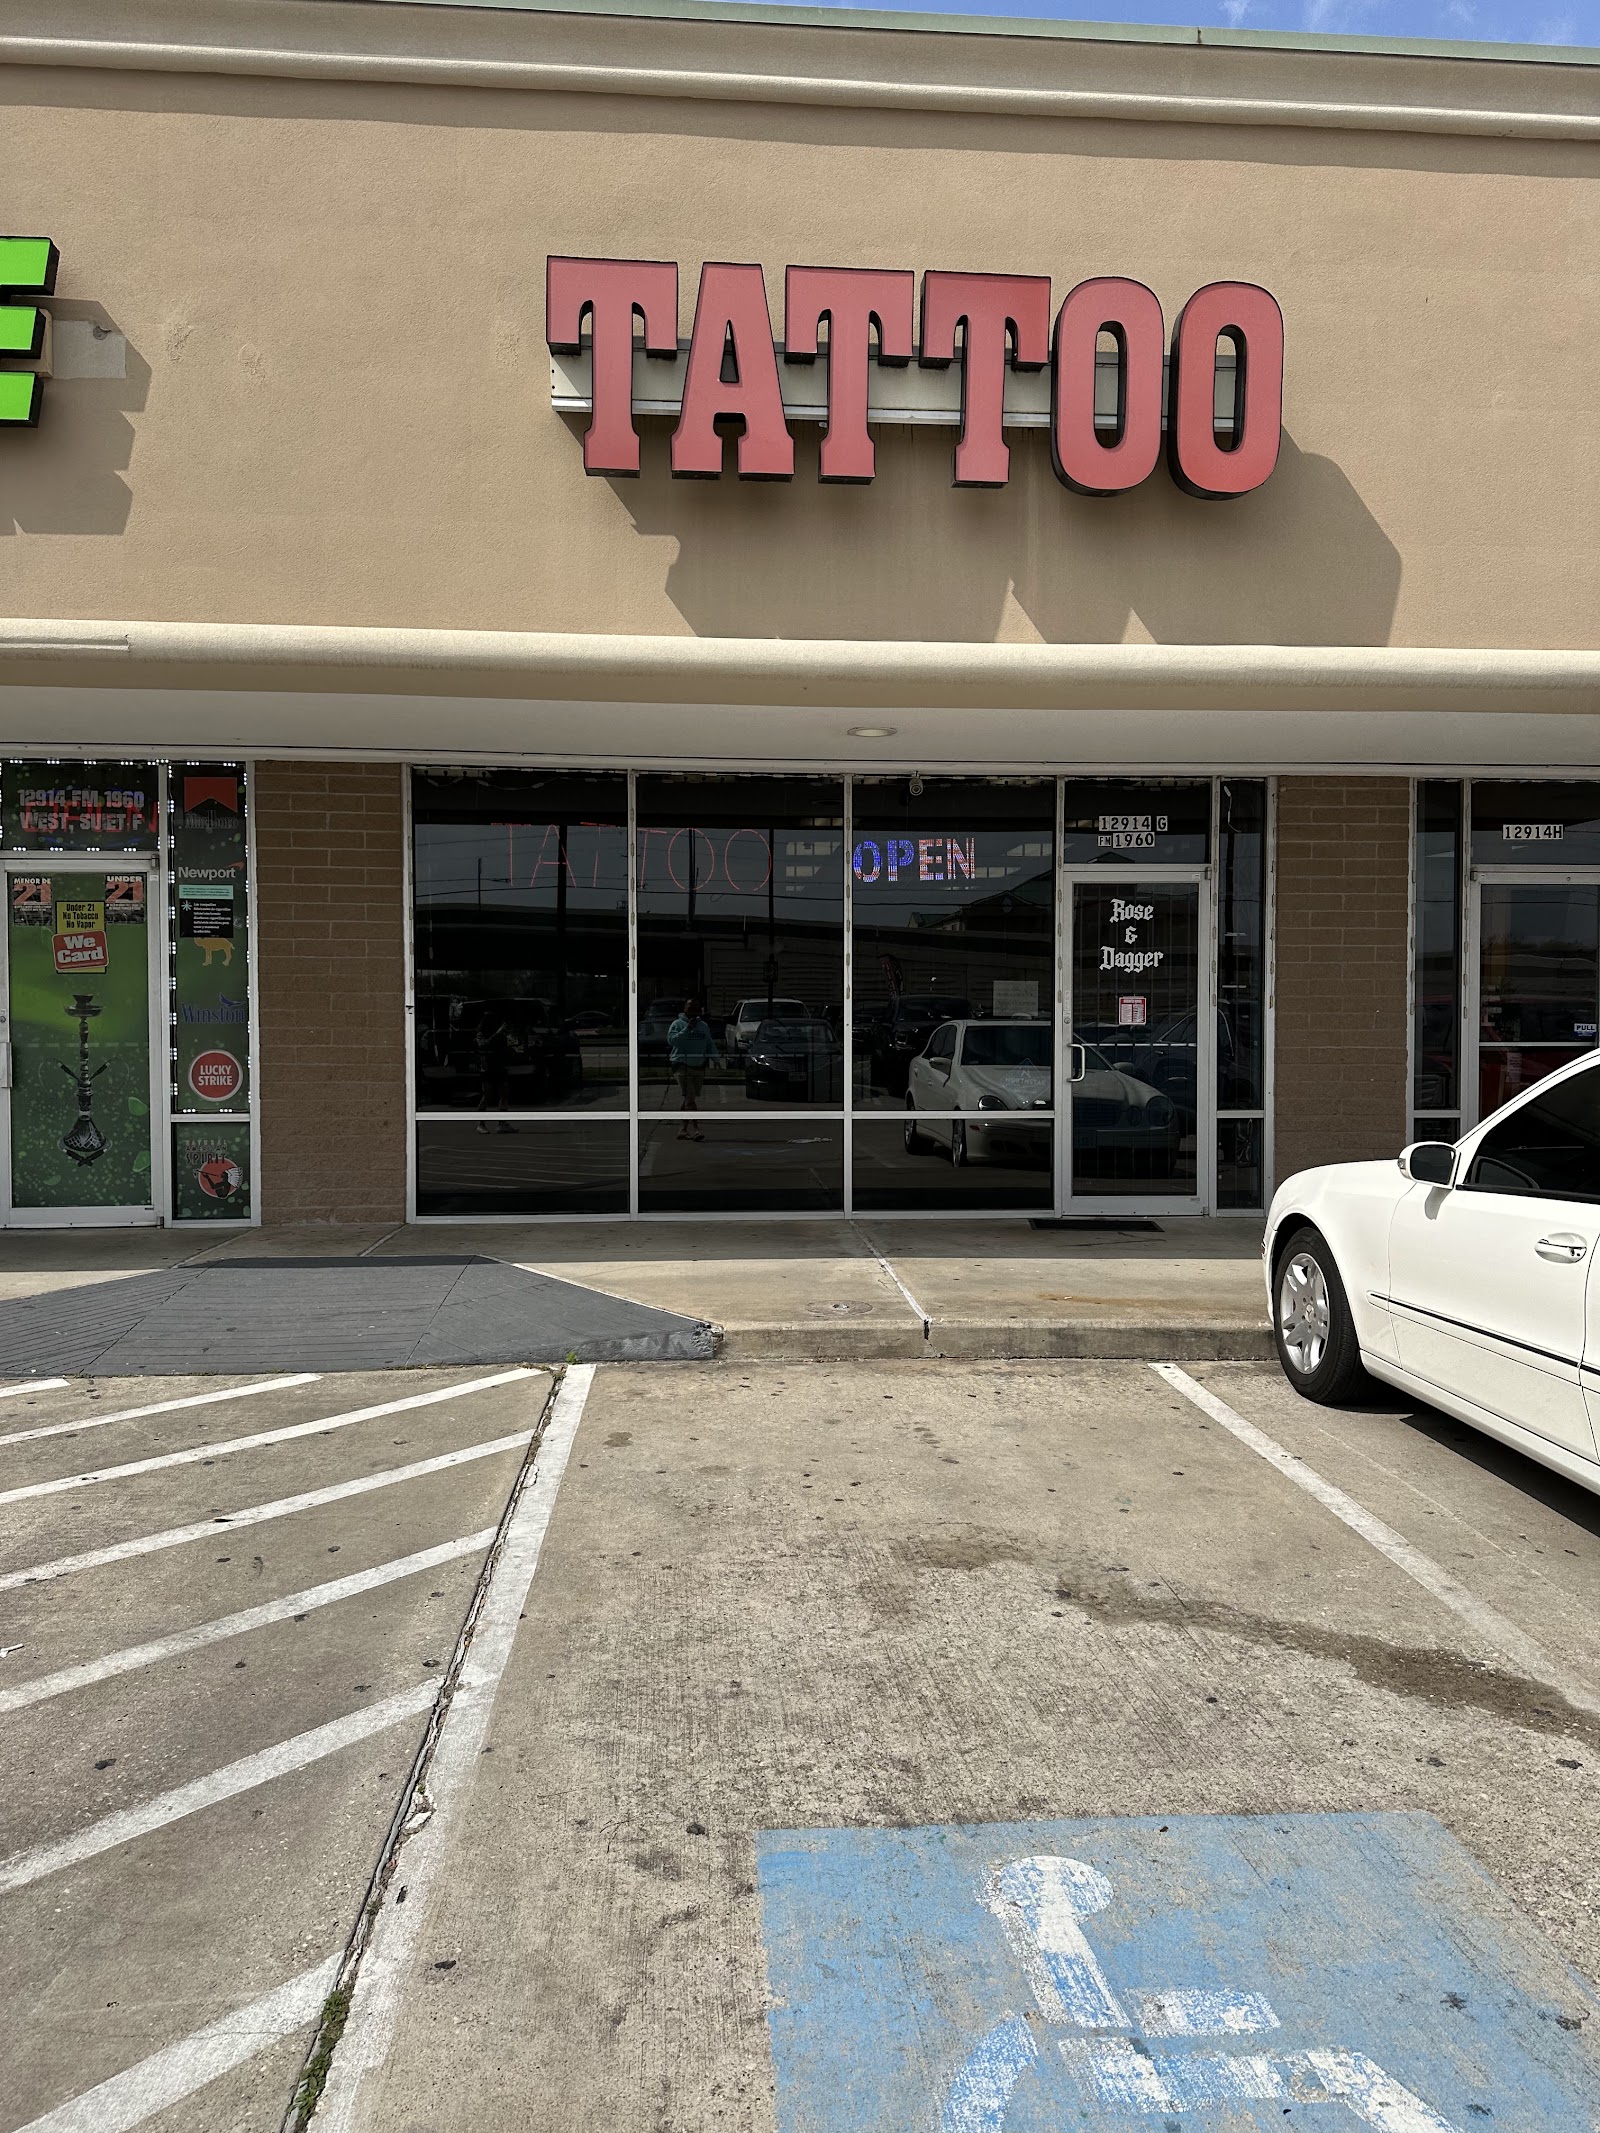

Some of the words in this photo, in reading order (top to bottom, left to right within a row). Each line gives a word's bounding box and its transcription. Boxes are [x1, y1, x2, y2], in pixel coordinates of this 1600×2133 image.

[545, 254, 1285, 502] TATTOO
[17, 789, 66, 806] 12914
[72, 790, 98, 807] FM
[104, 790, 145, 808] 1960
[19, 811, 74, 833] WEST,
[132, 814, 143, 831] F
[1101, 816, 1151, 830] 12914
[1157, 816, 1167, 830] G
[1099, 836, 1111, 846] FM
[1115, 833, 1154, 847] 1960
[1505, 825, 1563, 839] 12914H
[490, 822, 772, 891] TATTOO
[852, 837, 977, 883] OPEN
[41, 877, 52, 885] DE
[178, 866, 236, 880] Newport
[13, 884, 52, 905] 21
[105, 882, 144, 904] 21
[66, 903, 85, 911] Under
[87, 903, 95, 911] 21
[1110, 898, 1154, 923] Rose
[63, 912, 72, 920] No
[73, 912, 99, 920] Tobacco
[66, 920, 76, 928] No
[77, 920, 96, 929] Vapor
[63, 935, 96, 950] We
[1125, 926, 1138, 944] &
[57, 946, 104, 963] Card
[1099, 946, 1164, 973] Dagger
[181, 1001, 245, 1024] Winston
[200, 1065, 232, 1075] LUCKY
[198, 1076, 233, 1086] STRIKE
[184, 1152, 227, 1165] SPIRIT
